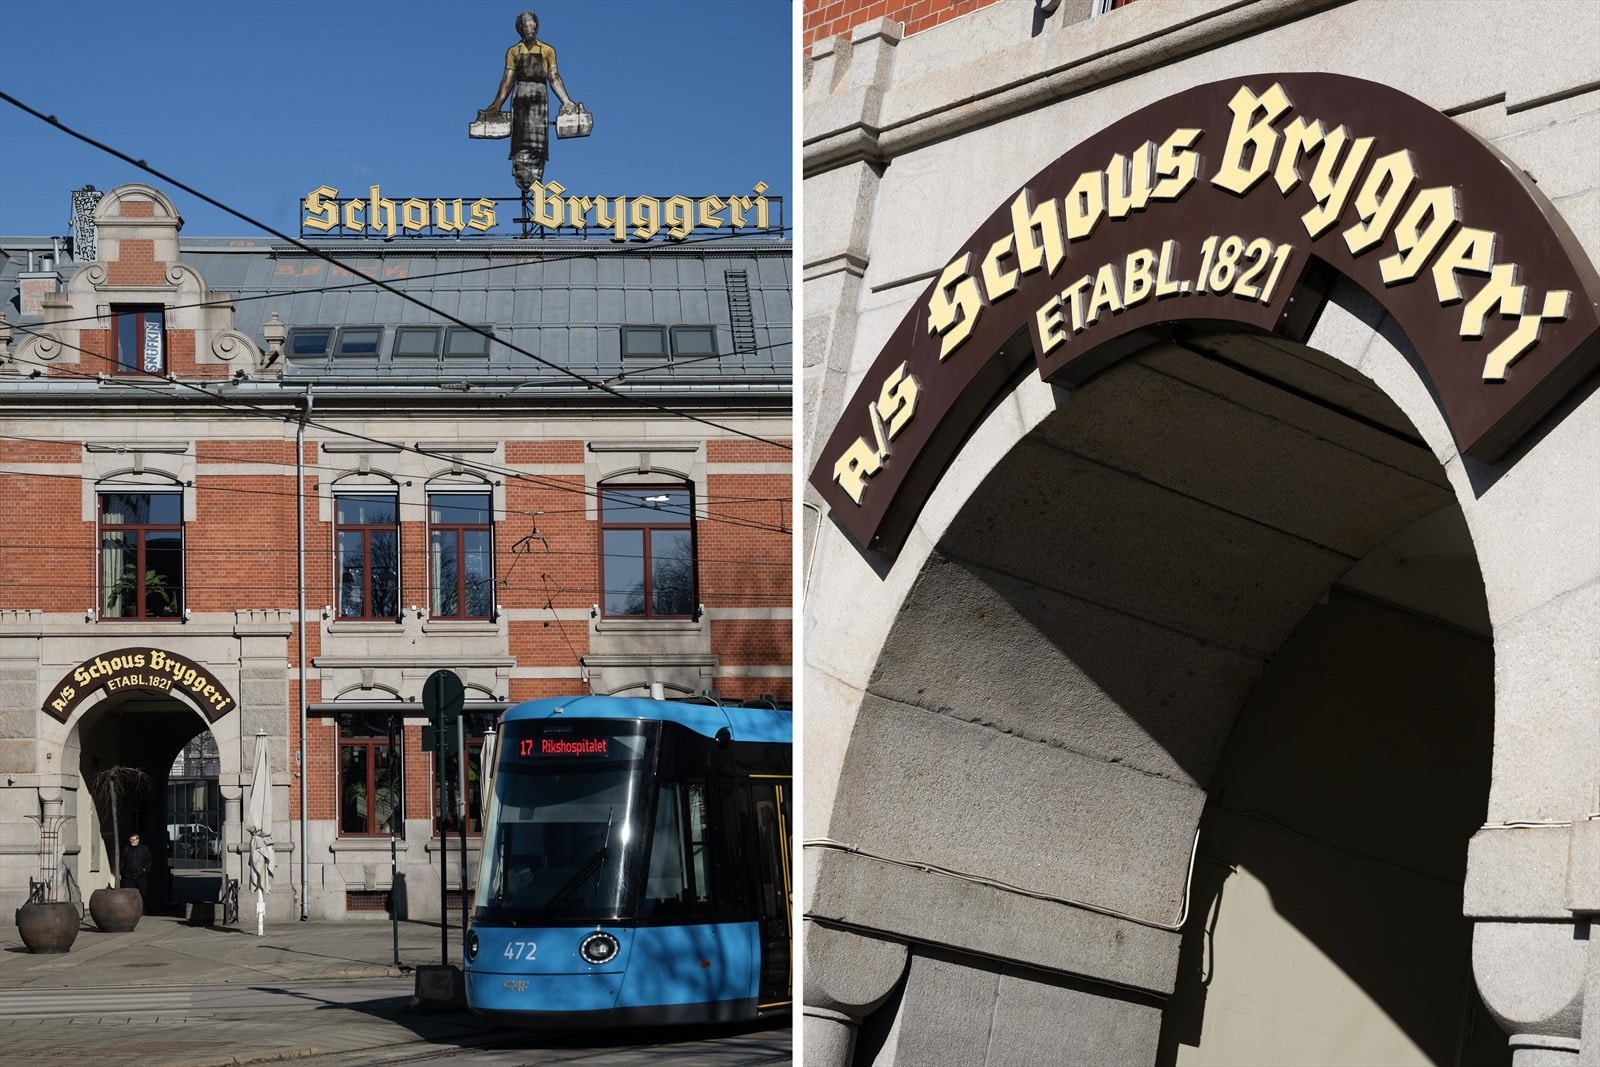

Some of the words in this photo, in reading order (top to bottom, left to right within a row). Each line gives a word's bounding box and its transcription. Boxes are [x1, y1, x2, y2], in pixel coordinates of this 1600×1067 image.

[303, 184, 497, 239] Schous
[529, 180, 769, 240] Bryggeri
[833, 360, 920, 505] A/S
[928, 128, 1206, 361] Schous
[1210, 82, 1572, 382] Bryggeri
[52, 685, 75, 712] A/S
[74, 656, 145, 687] Schous
[149, 650, 231, 710] Bryggeri
[520, 739, 534, 756] 17
[541, 738, 607, 756] Rikshospitalet
[503, 942, 537, 960] 472
